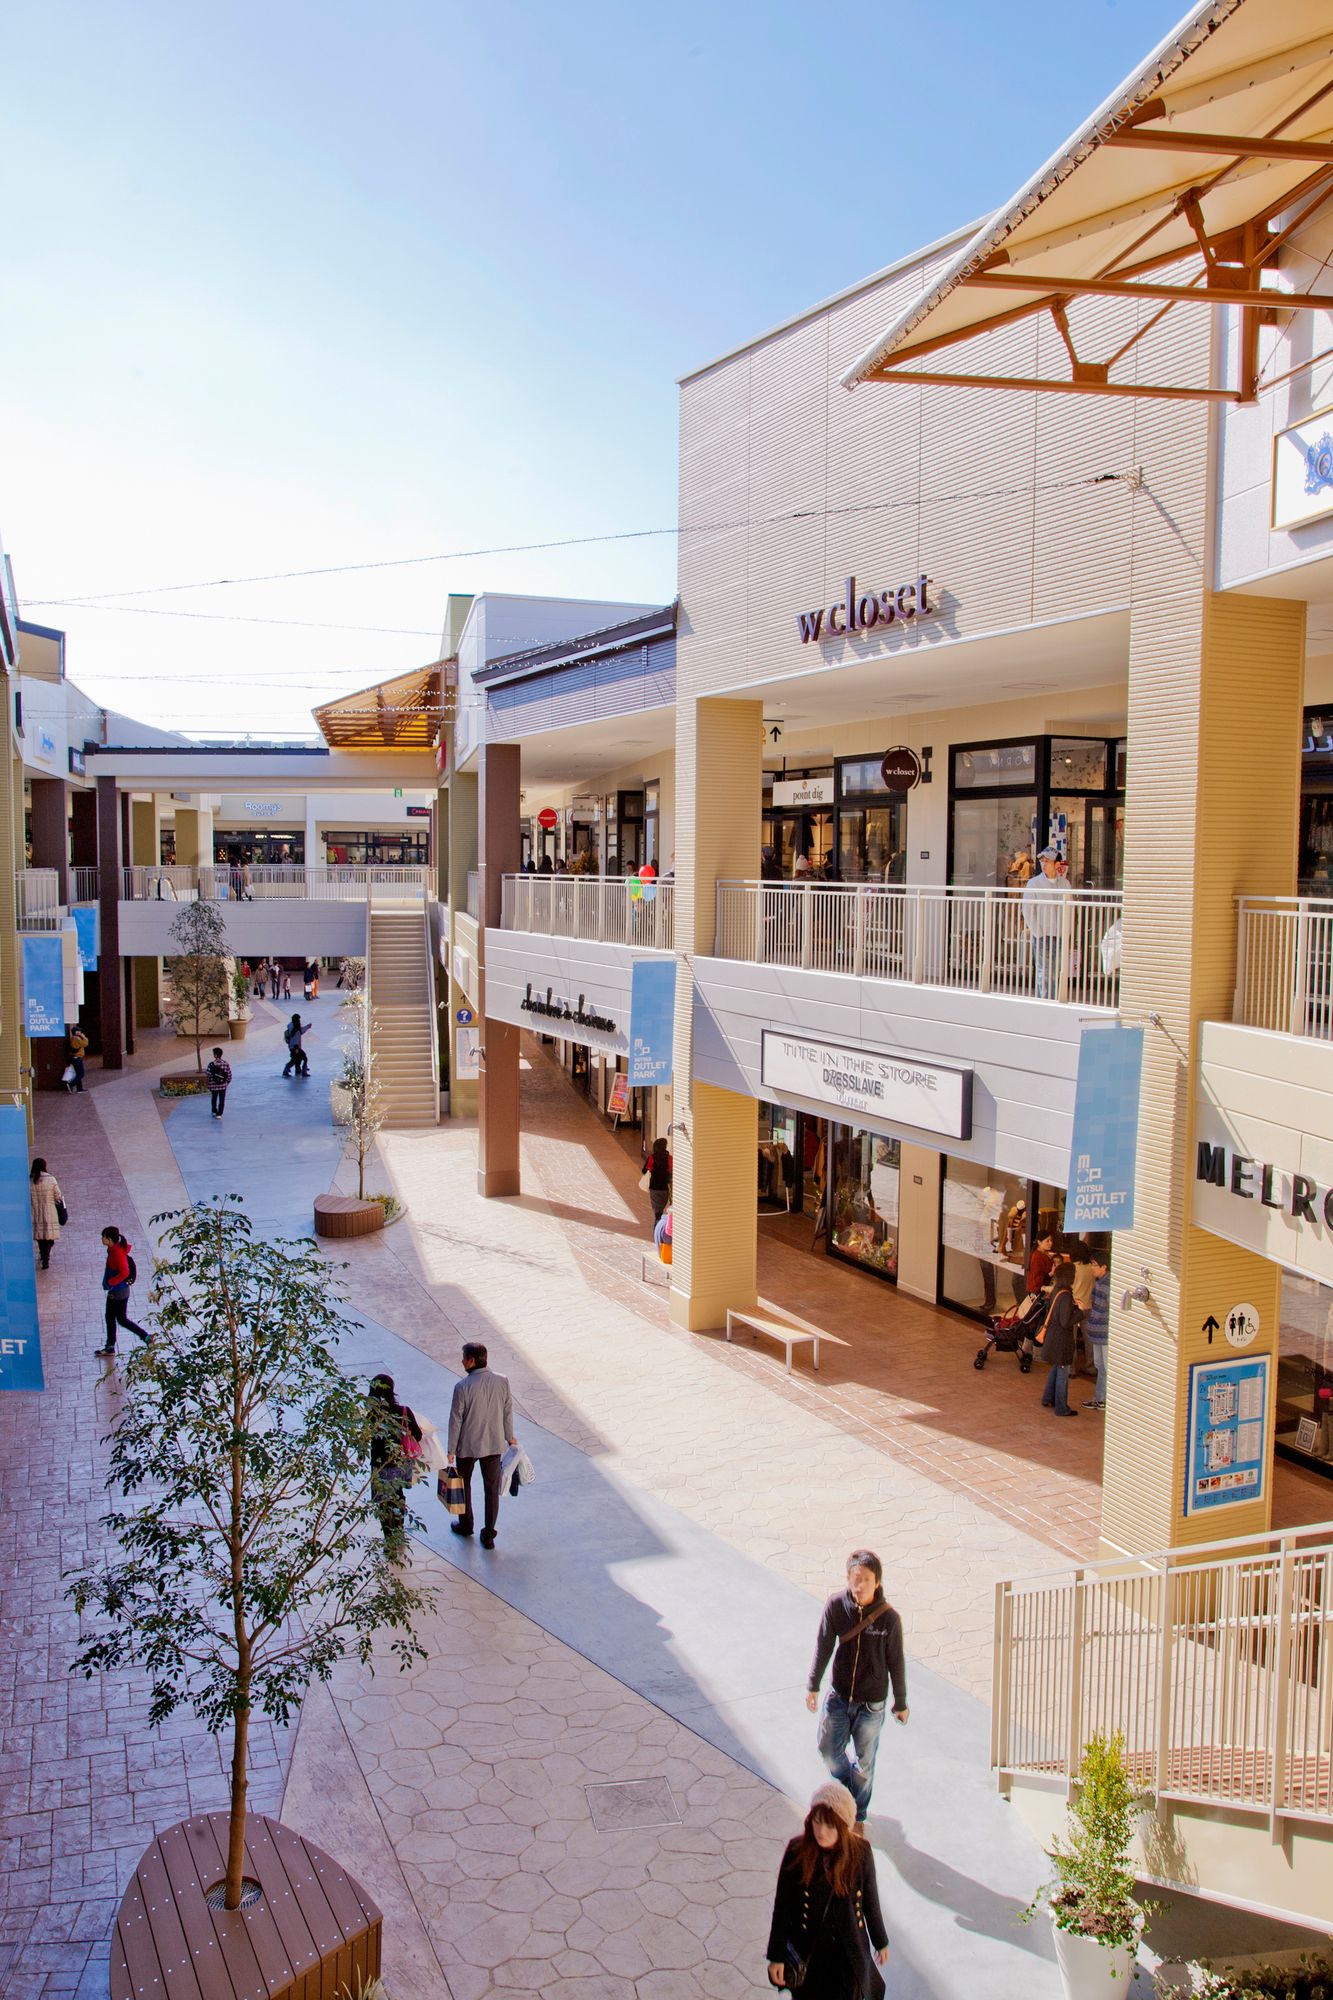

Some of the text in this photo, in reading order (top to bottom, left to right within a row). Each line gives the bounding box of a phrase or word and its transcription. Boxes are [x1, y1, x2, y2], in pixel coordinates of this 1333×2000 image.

[797, 574, 934, 644] w closet
[885, 766, 915, 776] w closet
[793, 785, 824, 804] point dig
[29, 1017, 59, 1025] OUTLET
[29, 1024, 51, 1032] PARK
[633, 1061, 667, 1071] OUTLET
[783, 1043, 938, 1091] TITE IN THE STORE
[633, 1070, 656, 1079] PARK
[823, 1068, 882, 1097] DRESSLAVE
[1077, 1184, 1104, 1194] MITSUI
[1075, 1191, 1127, 1206] OUTLET
[1074, 1206, 1110, 1220] PARK
[0, 1338, 27, 1355] ET
